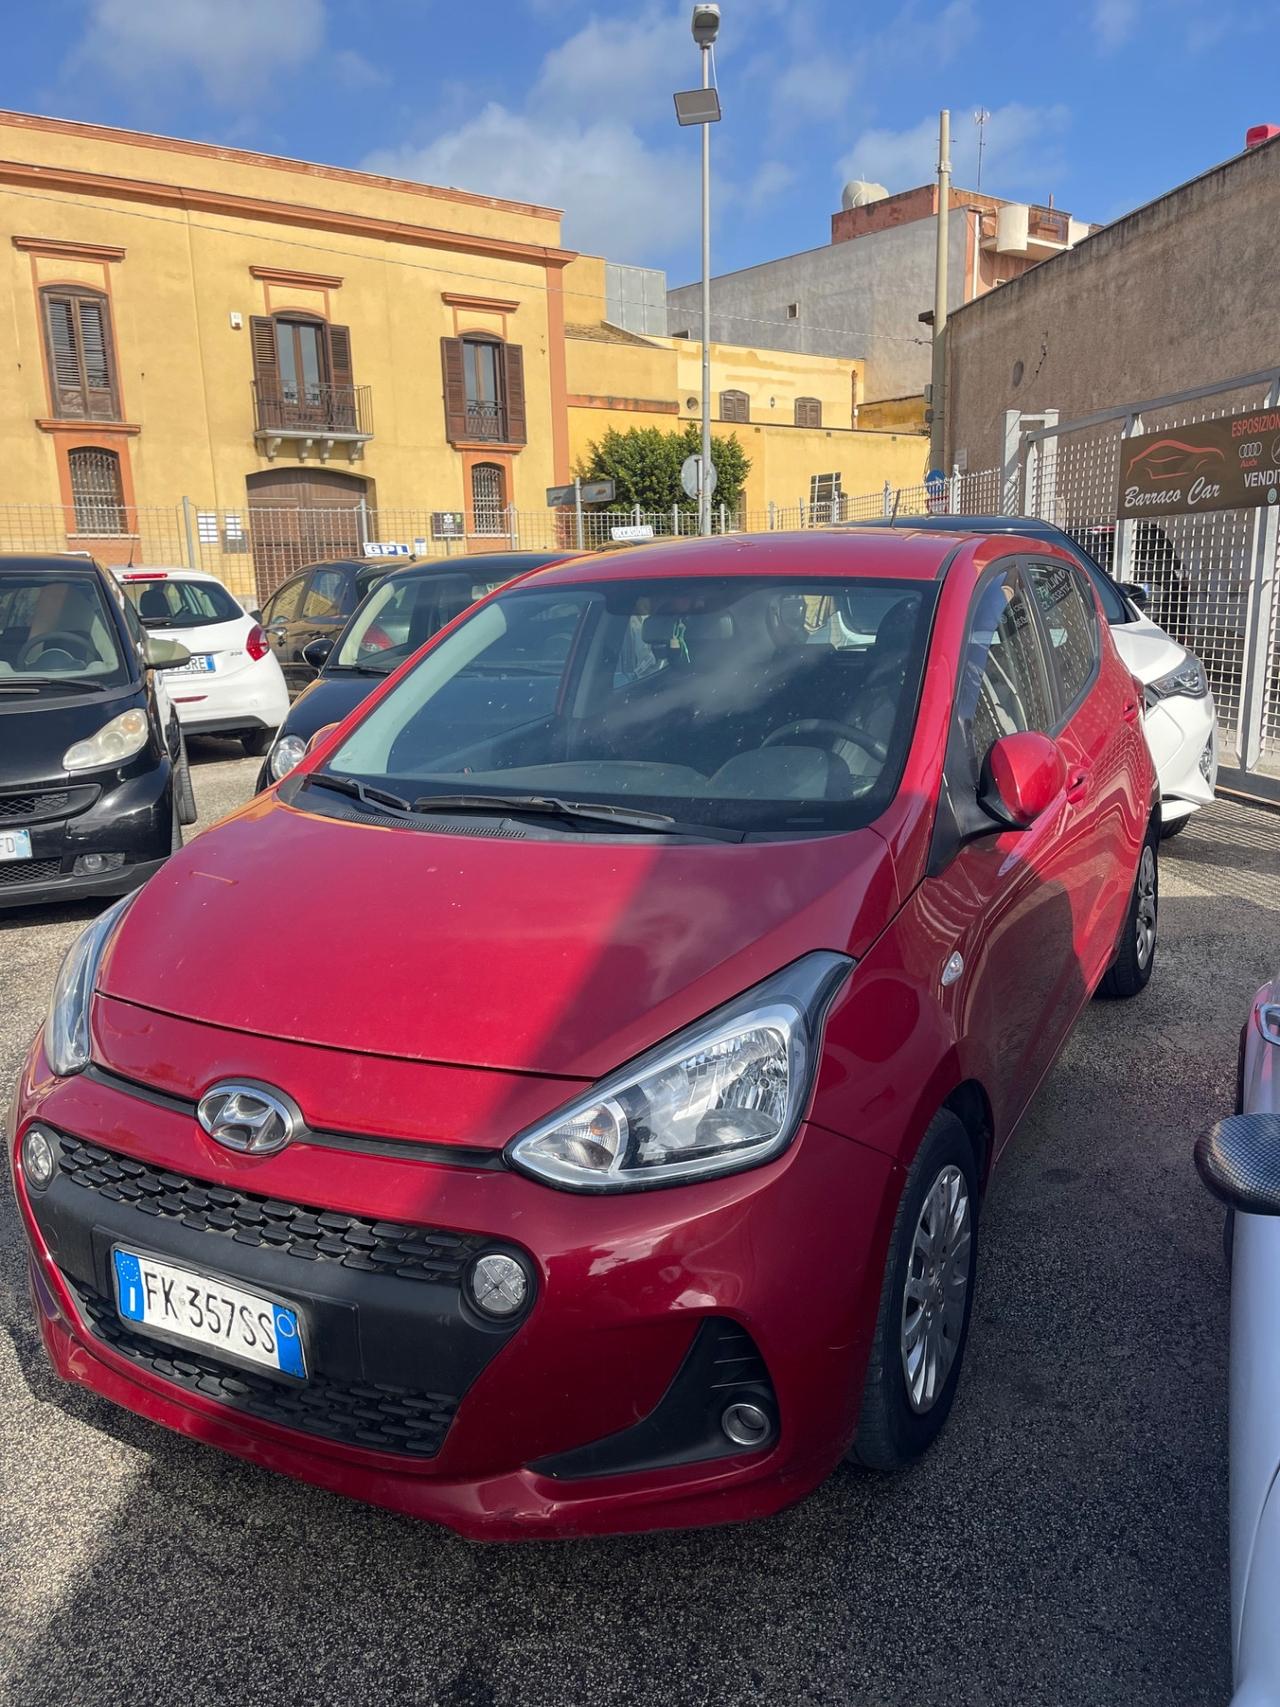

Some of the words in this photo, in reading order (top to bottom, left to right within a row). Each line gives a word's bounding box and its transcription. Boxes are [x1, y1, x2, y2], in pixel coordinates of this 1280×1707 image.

[1124, 485, 1181, 508] Barraco
[1187, 476, 1221, 505] Car
[366, 544, 409, 555] GPL
